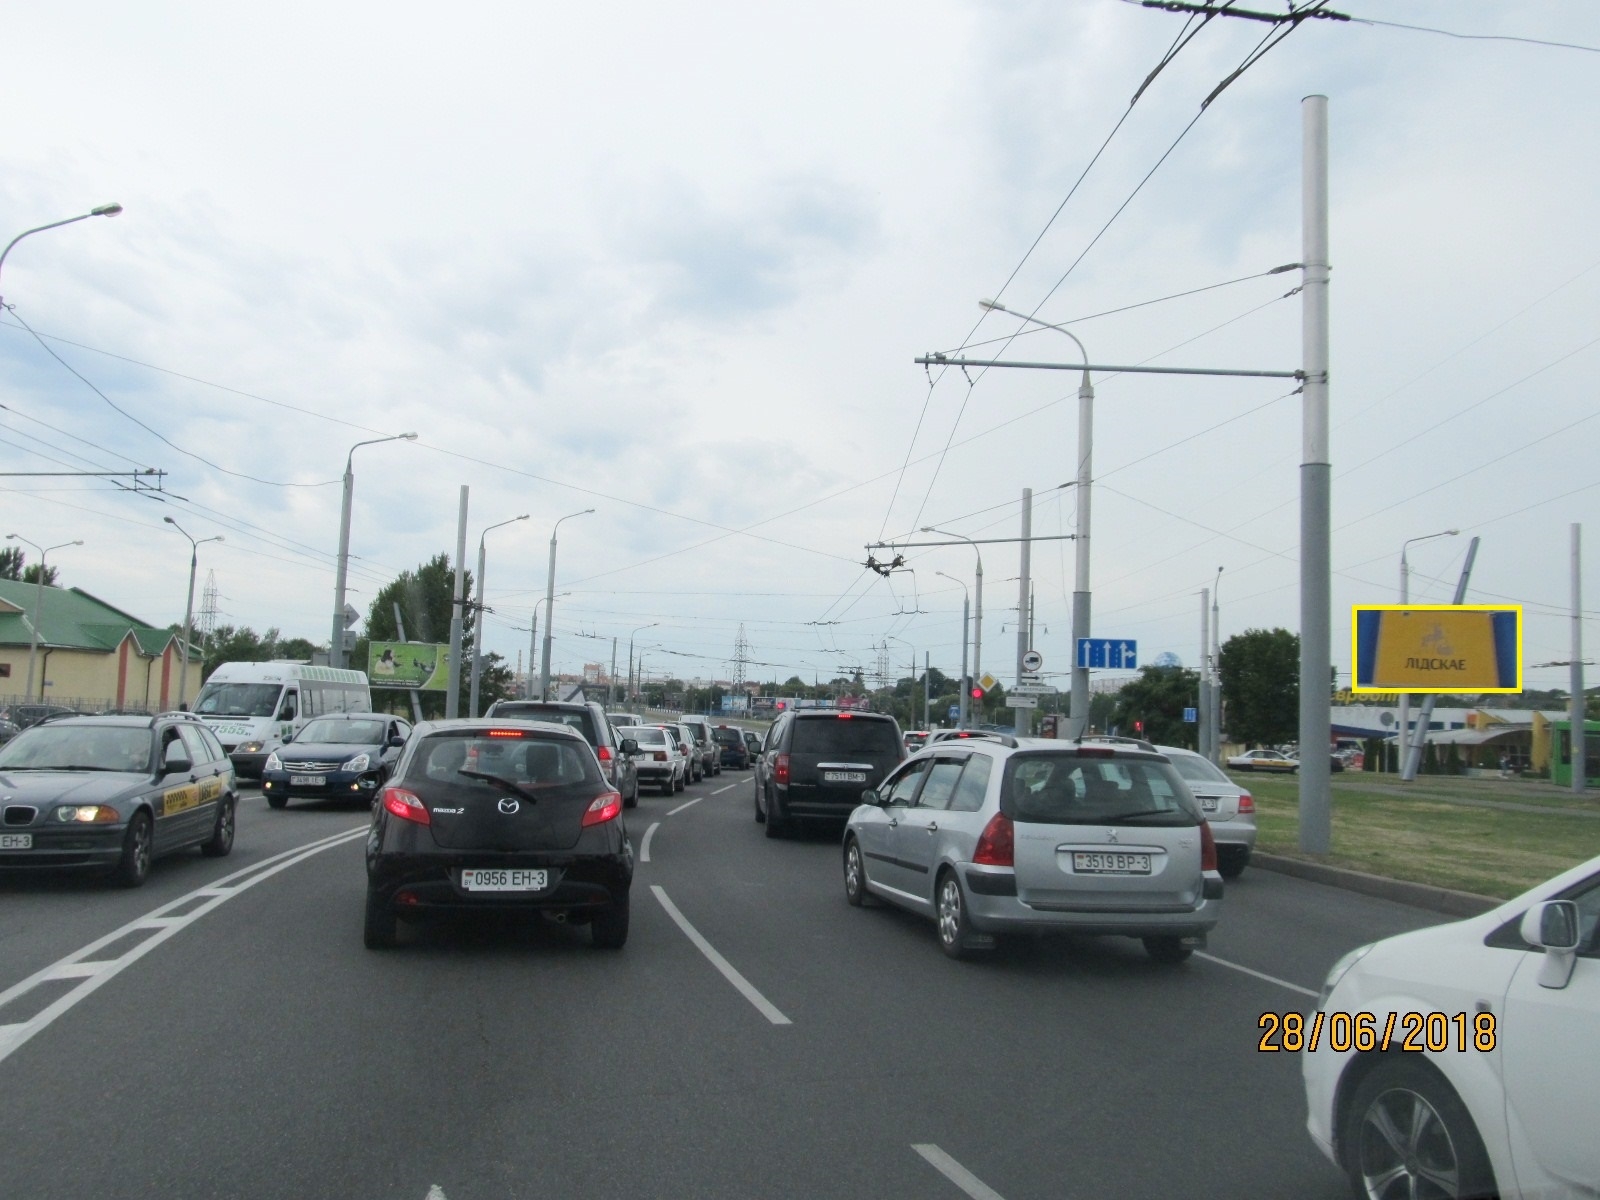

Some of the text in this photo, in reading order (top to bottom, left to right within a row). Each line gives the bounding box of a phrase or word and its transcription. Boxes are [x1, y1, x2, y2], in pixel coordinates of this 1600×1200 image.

[1404, 657, 1467, 671] ЛІДСКАЕ
[2, 835, 31, 848] EH-3
[1085, 854, 1114, 869] 3519
[1117, 855, 1149, 870] BP-3
[475, 871, 507, 886] 0956
[512, 871, 545, 886] EH-3
